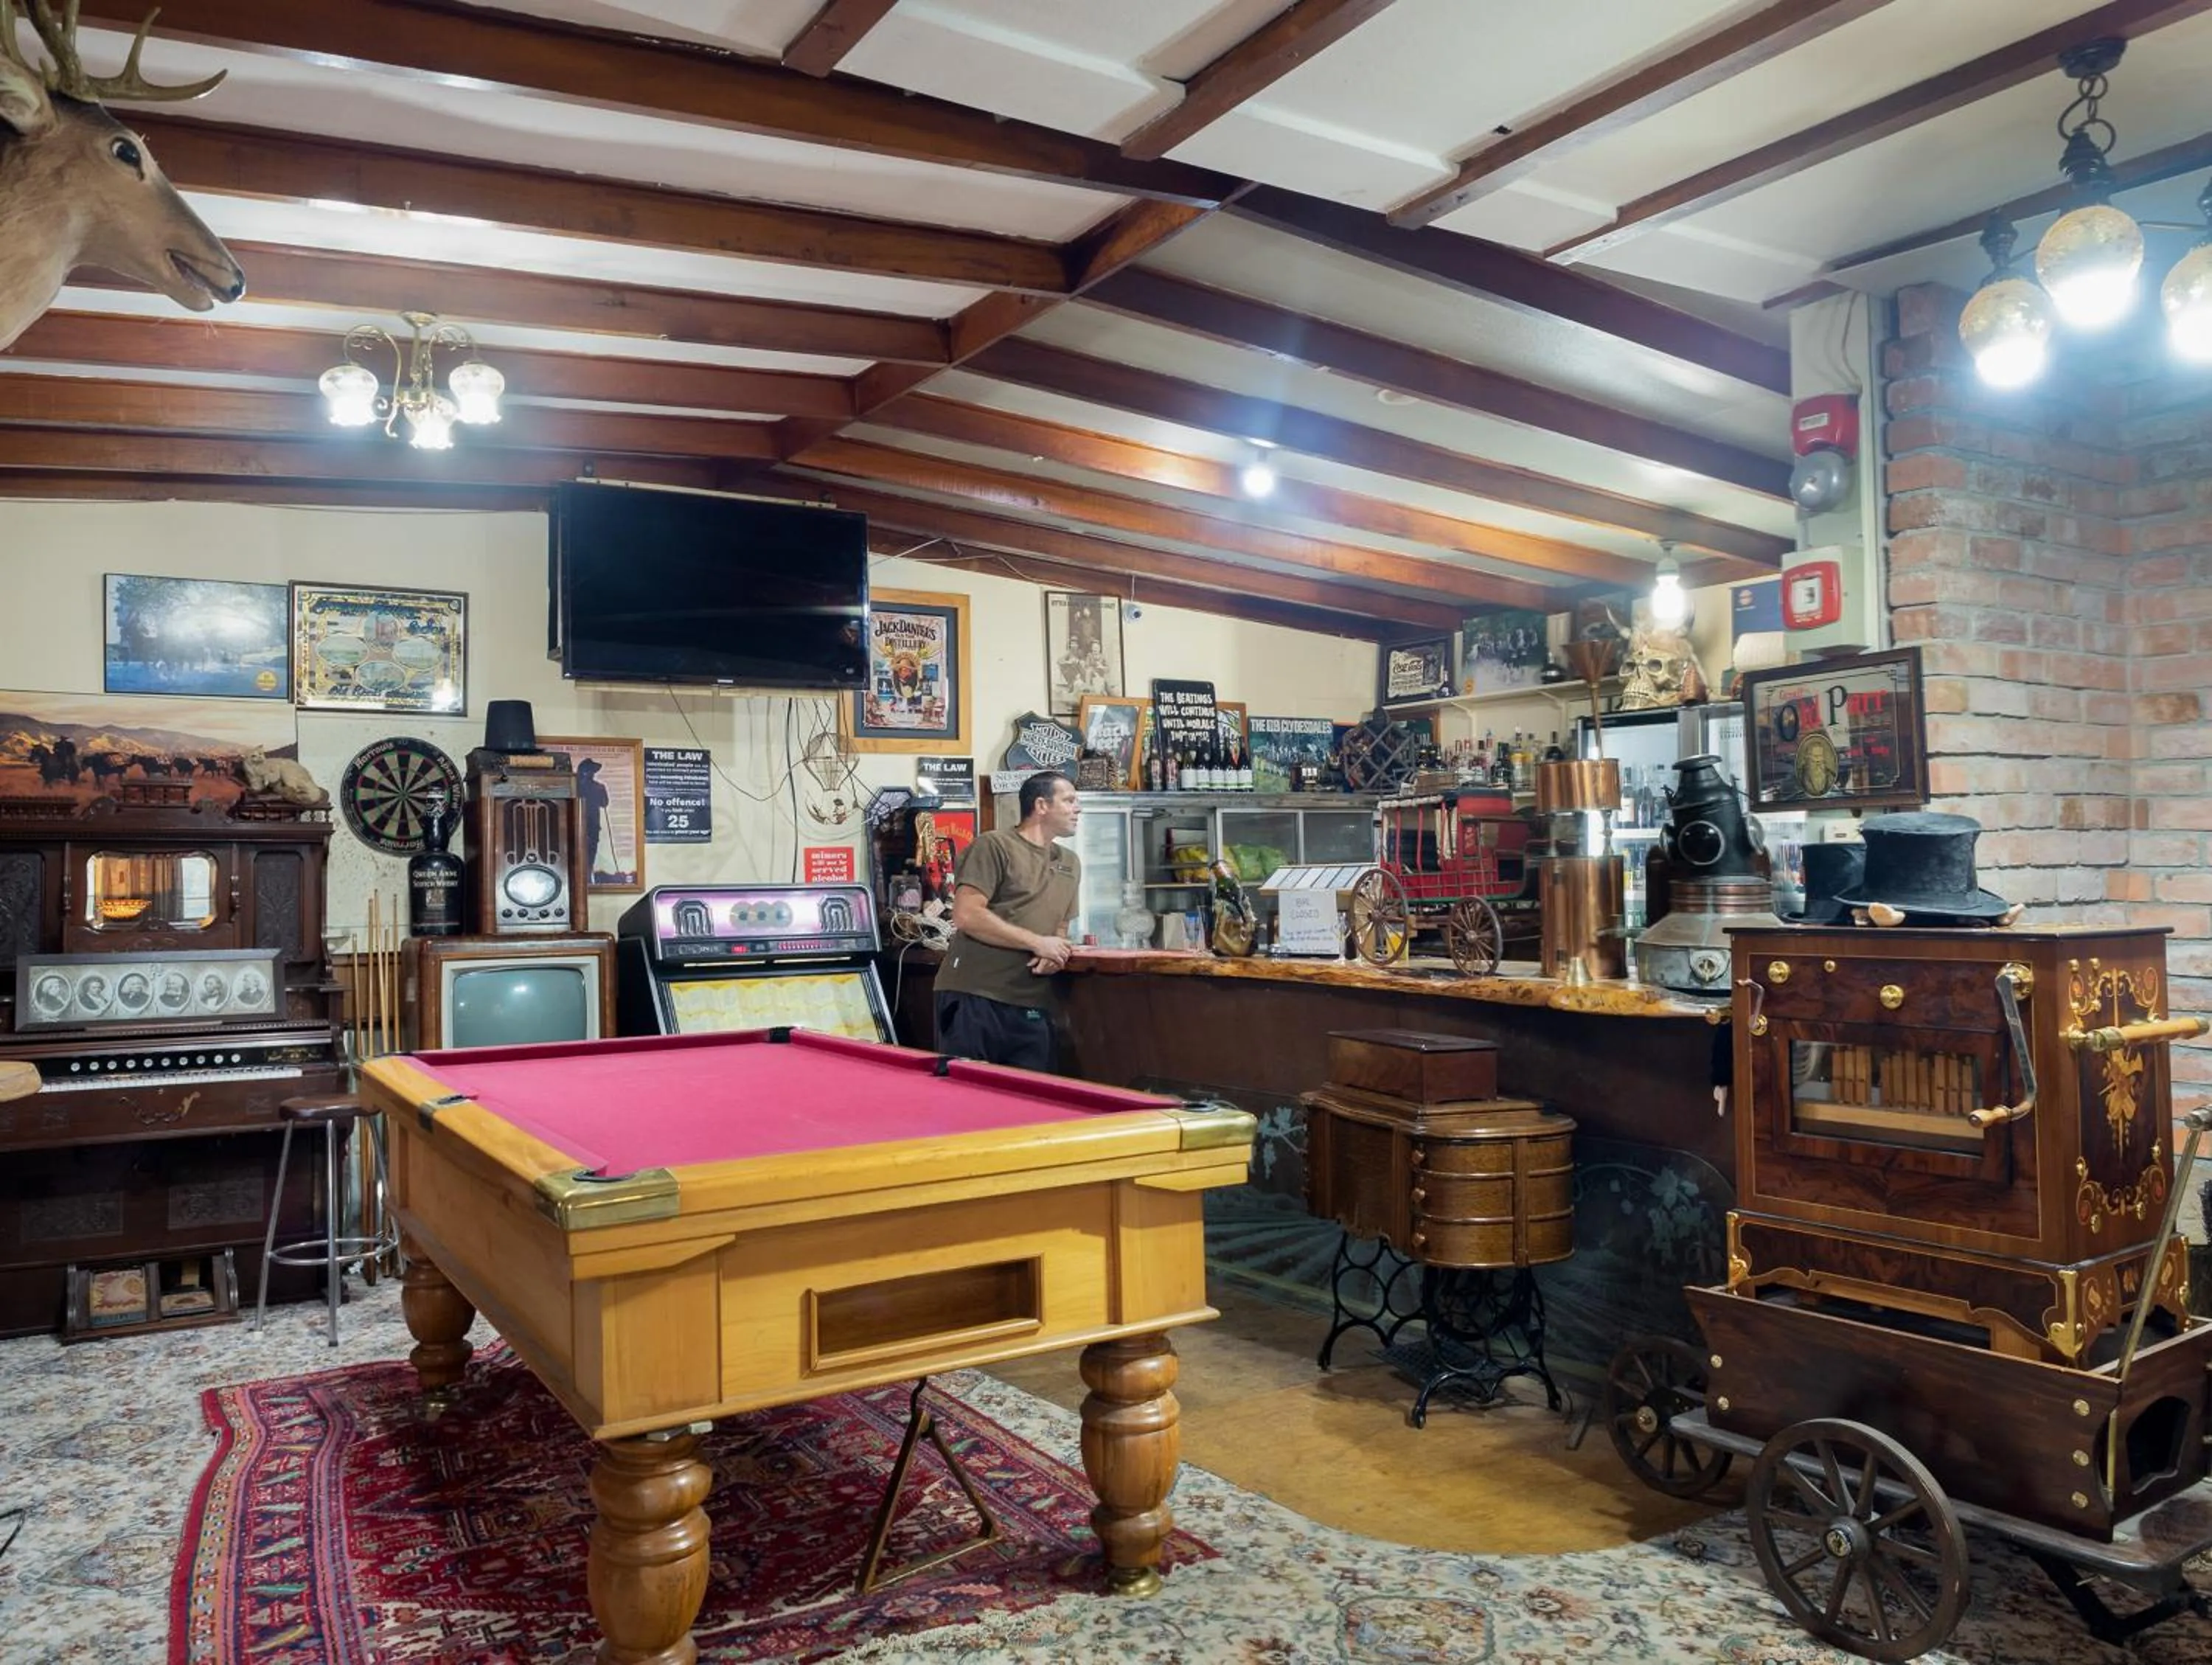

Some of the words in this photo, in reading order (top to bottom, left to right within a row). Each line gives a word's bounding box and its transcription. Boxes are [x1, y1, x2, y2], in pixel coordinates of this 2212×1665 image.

[874, 621, 900, 637] JACK
[1160, 692, 1175, 703] THE
[1176, 692, 1213, 704] BEATINGS
[1158, 705, 1179, 716] WILL
[1180, 706, 1215, 717] CONTINUE
[1778, 694, 1822, 740] Old
[1826, 686, 1888, 726] Parr
[1162, 718, 1185, 729] UNTIL
[1186, 718, 1216, 729] MORALE
[1251, 719, 1265, 731] THE
[1281, 720, 1332, 734] CLYDESDALES
[1034, 725, 1070, 742] MOTOR
[354, 742, 394, 769] Harrows
[652, 751, 675, 760] THE
[678, 751, 703, 762] LAW
[923, 763, 942, 771] THE
[944, 763, 967, 772] LAW
[650, 797, 664, 806] No
[666, 797, 706, 806] offence!
[667, 814, 689, 828] 25
[812, 873, 847, 882] alcohol
